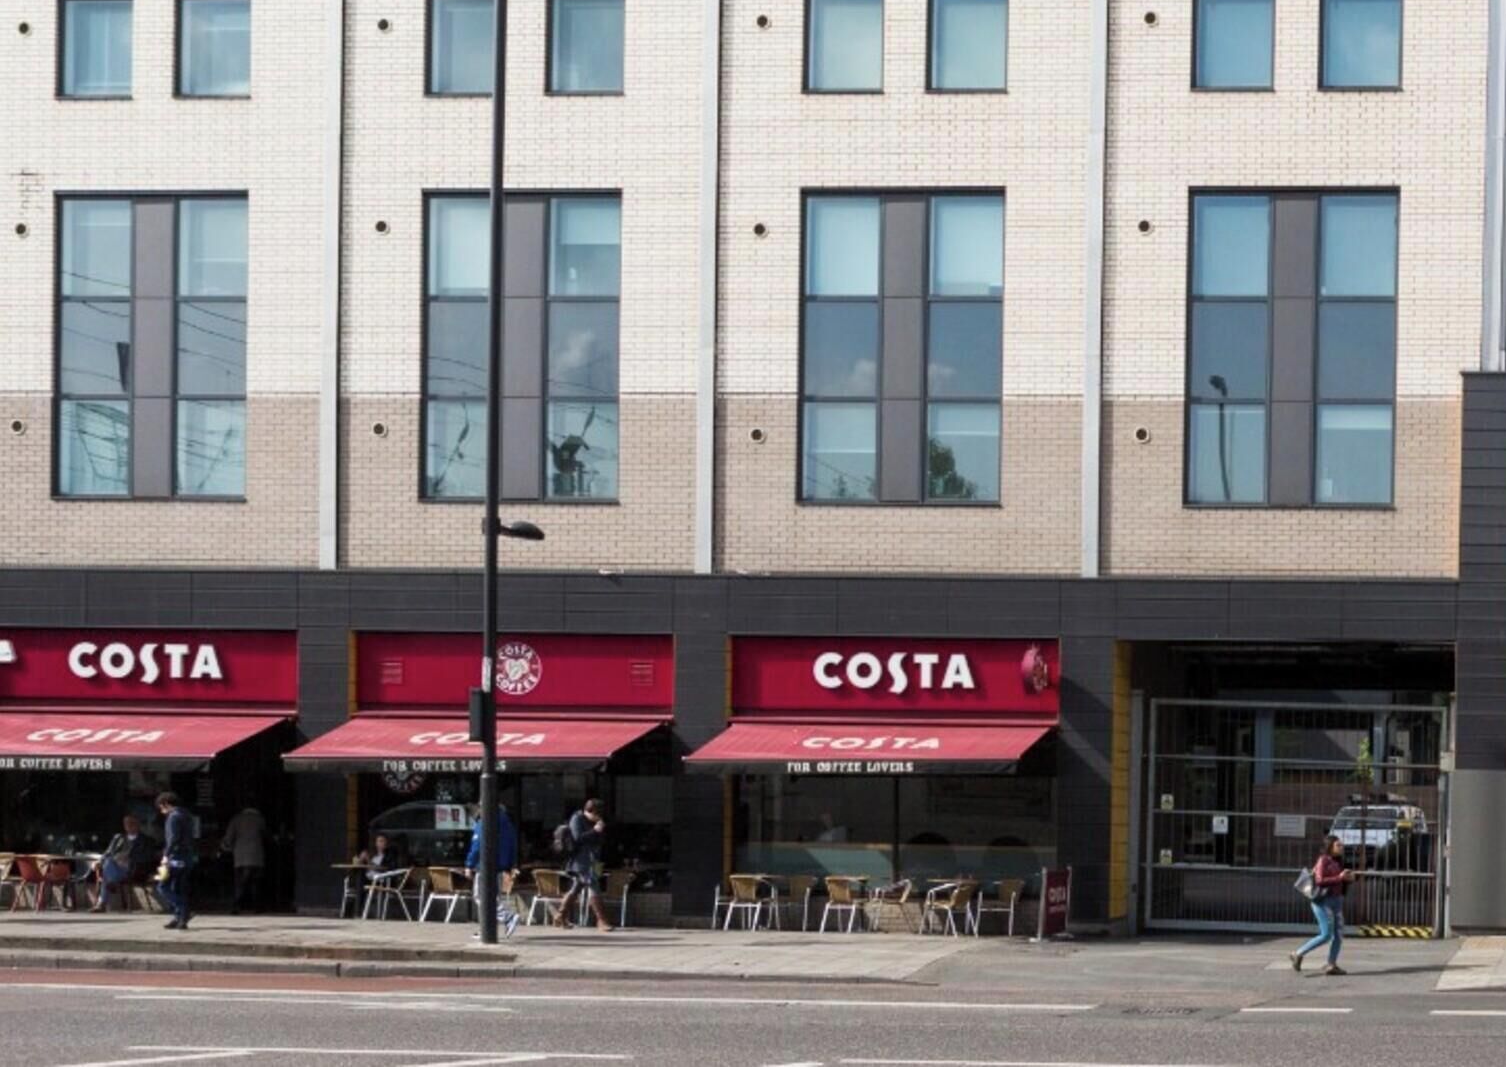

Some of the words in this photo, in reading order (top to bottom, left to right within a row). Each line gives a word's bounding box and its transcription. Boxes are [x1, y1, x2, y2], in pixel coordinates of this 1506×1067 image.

[68, 641, 223, 684] COSTA
[812, 652, 976, 694] COSTA
[26, 729, 166, 742] COSTA
[409, 731, 546, 745] COTA
[802, 737, 940, 749] COSTA
[0, 758, 14, 768] OR
[19, 758, 63, 769] COFFEE
[67, 759, 112, 770] LOVERS
[383, 760, 408, 772] FOR
[412, 760, 456, 772] COFFEE
[461, 760, 507, 772] LOVS
[787, 762, 811, 773] FOR
[816, 762, 862, 773] COFFEE
[866, 762, 914, 773] LOVERS
